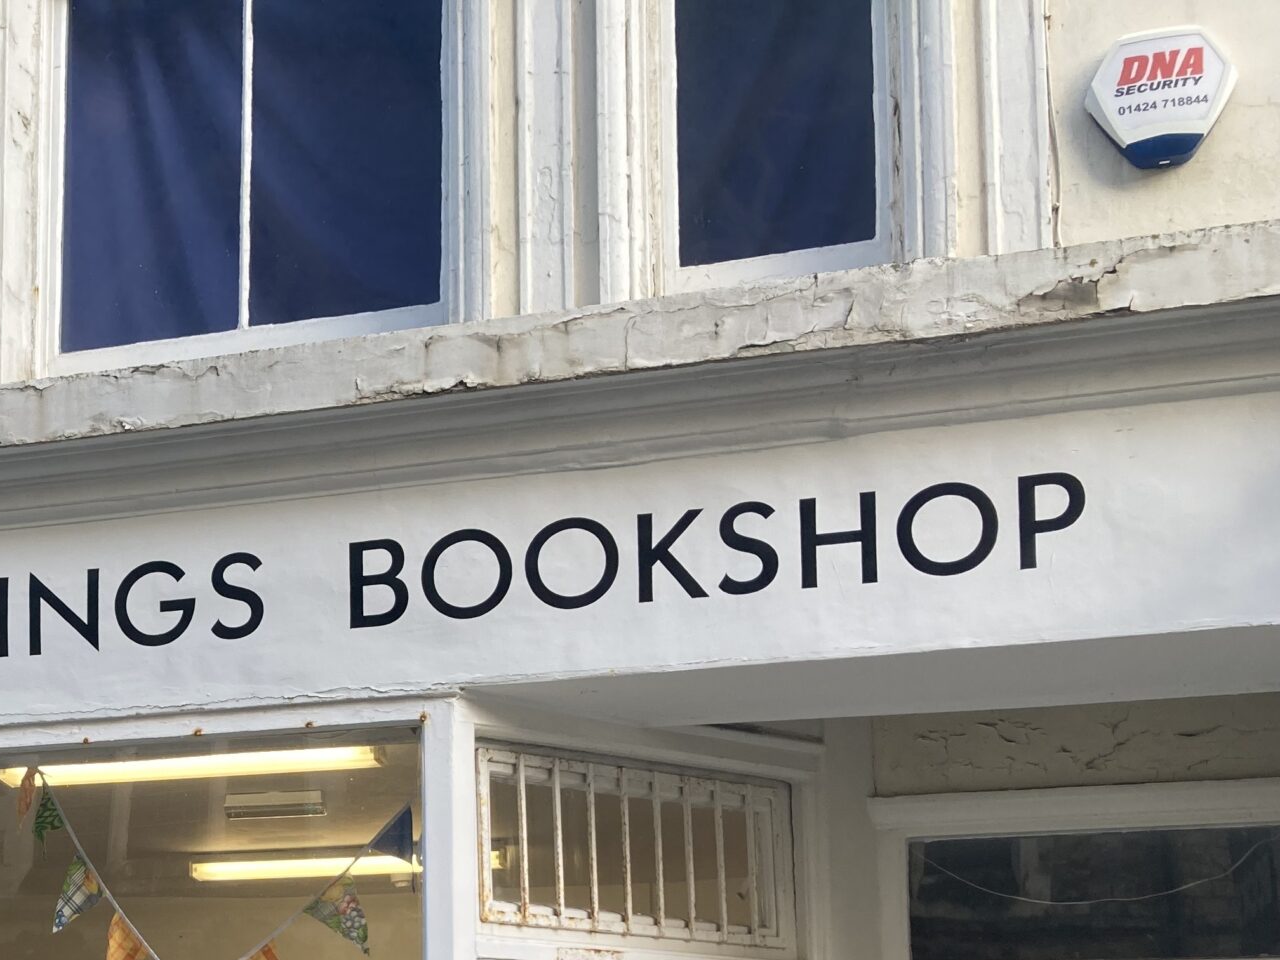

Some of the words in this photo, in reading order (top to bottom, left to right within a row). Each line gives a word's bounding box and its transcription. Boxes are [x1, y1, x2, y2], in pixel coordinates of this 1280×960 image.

[1117, 46, 1204, 87] DNA
[1114, 75, 1203, 98] SECURITY
[1118, 100, 1158, 116] 01424
[1162, 94, 1209, 109] 718844
[348, 471, 1087, 629] BOOKSHOP
